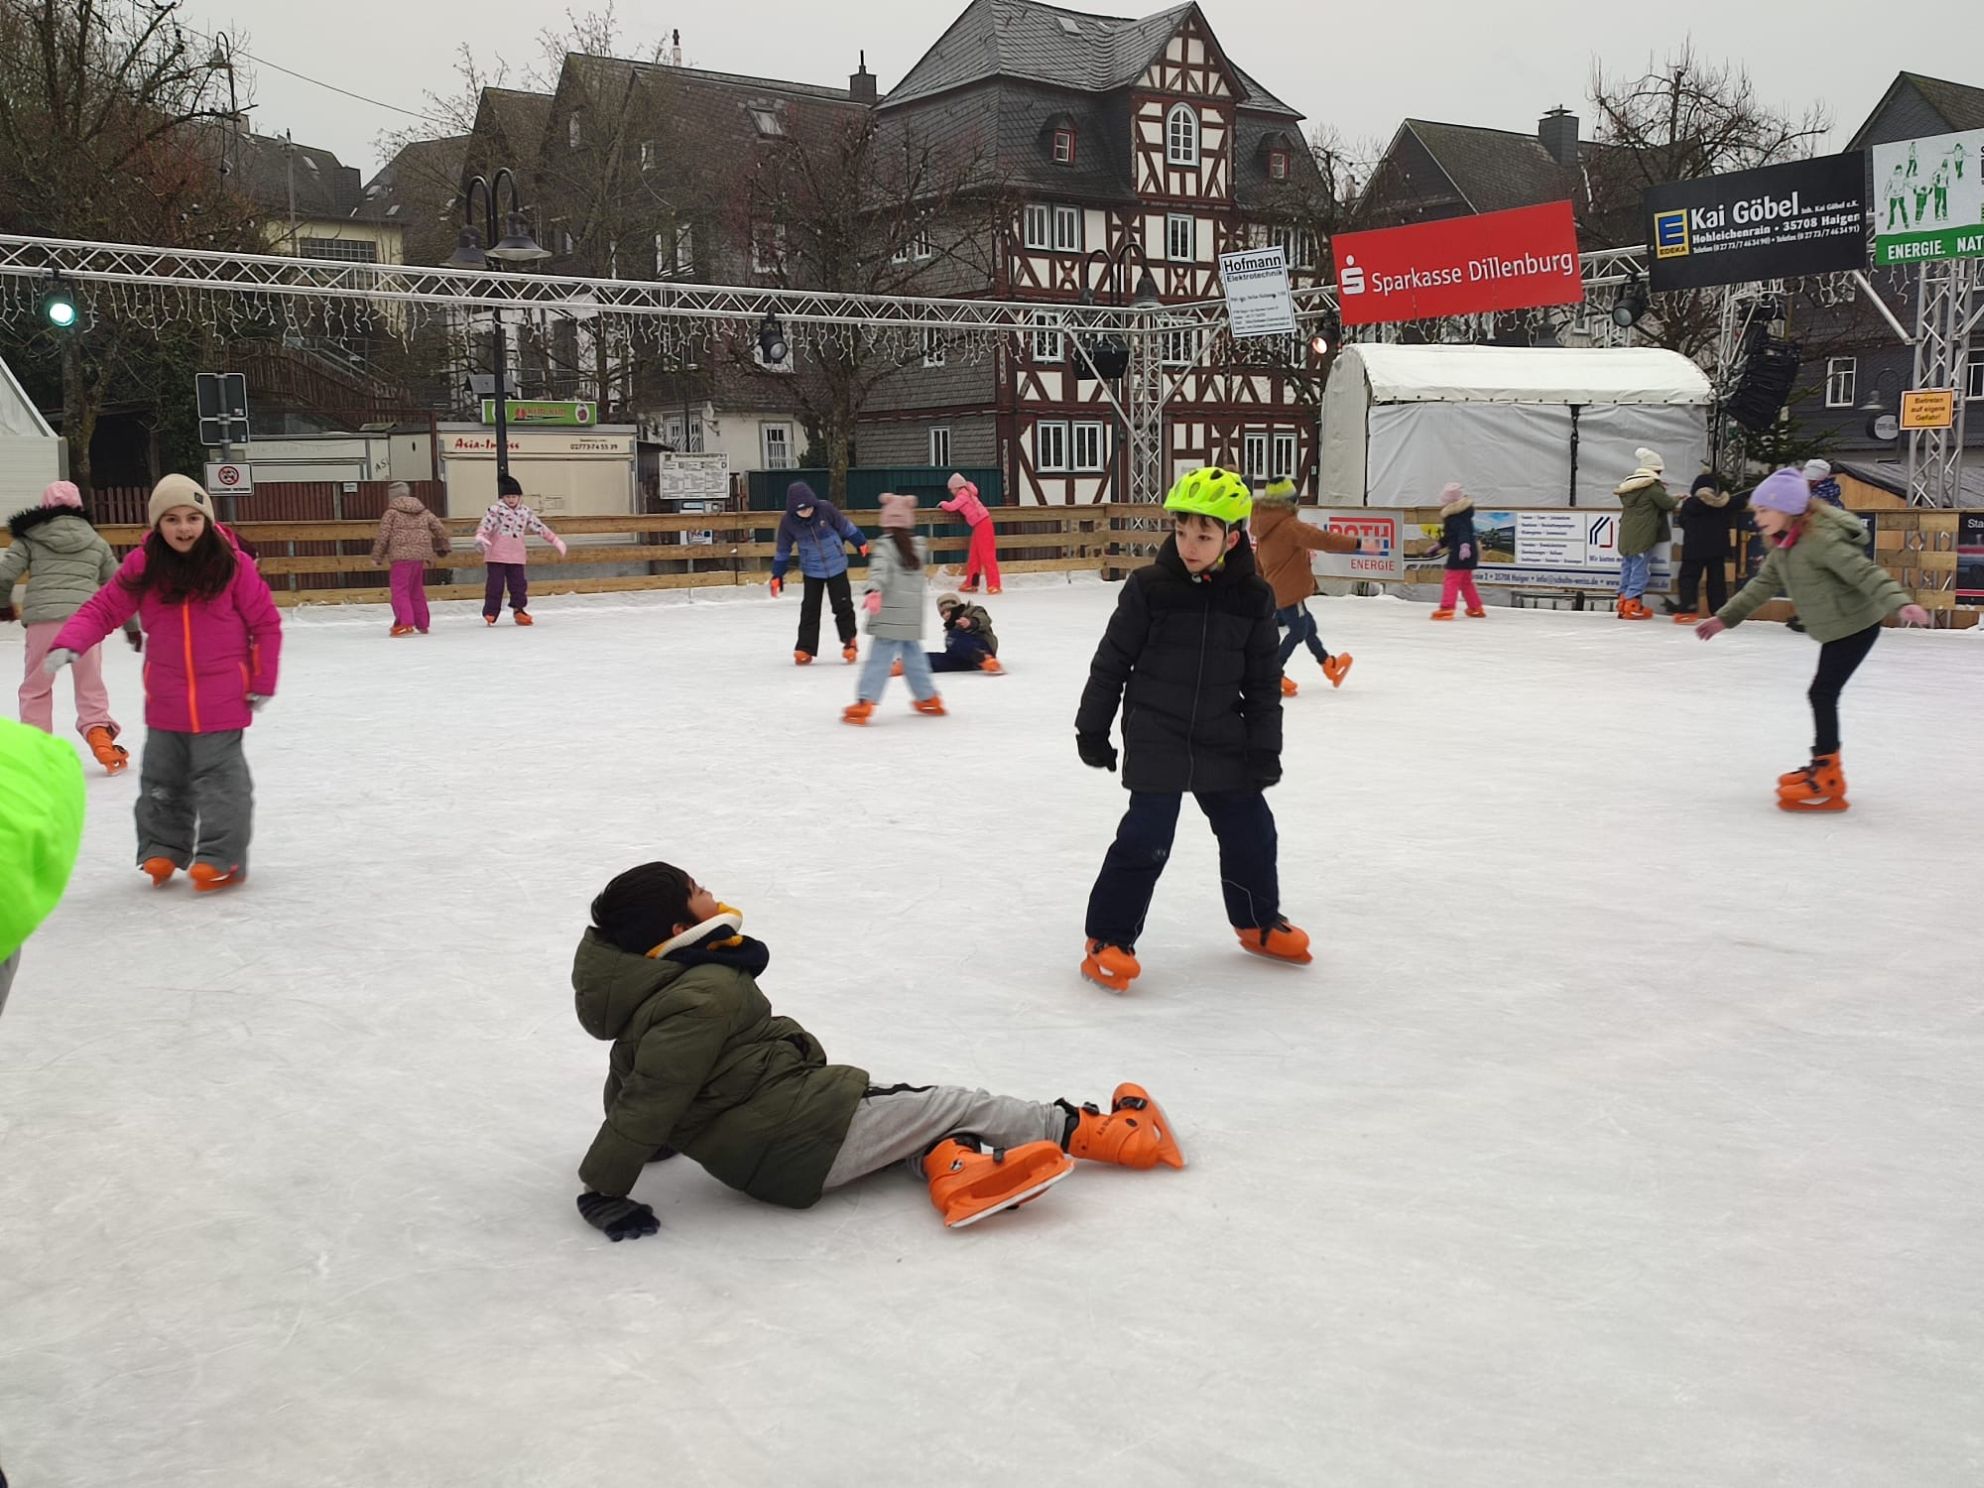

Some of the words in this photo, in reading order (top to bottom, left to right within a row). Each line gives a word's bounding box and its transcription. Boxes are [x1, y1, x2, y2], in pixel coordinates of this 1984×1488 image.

[1690, 205, 1725, 230] Kai
[1732, 191, 1799, 223] Göbel
[1692, 226, 1771, 244] Hohleichenrain
[1782, 217, 1818, 232] 35708
[1887, 240, 1946, 260] ENERGIE.
[1957, 235, 1984, 252] NAT
[1223, 255, 1282, 272] Hofmann
[1226, 270, 1282, 282] Elektrotechnik
[1371, 267, 1462, 296] Sparkasse
[1468, 252, 1573, 281] Dillenburg
[1351, 559, 1395, 571] ENERGIE
